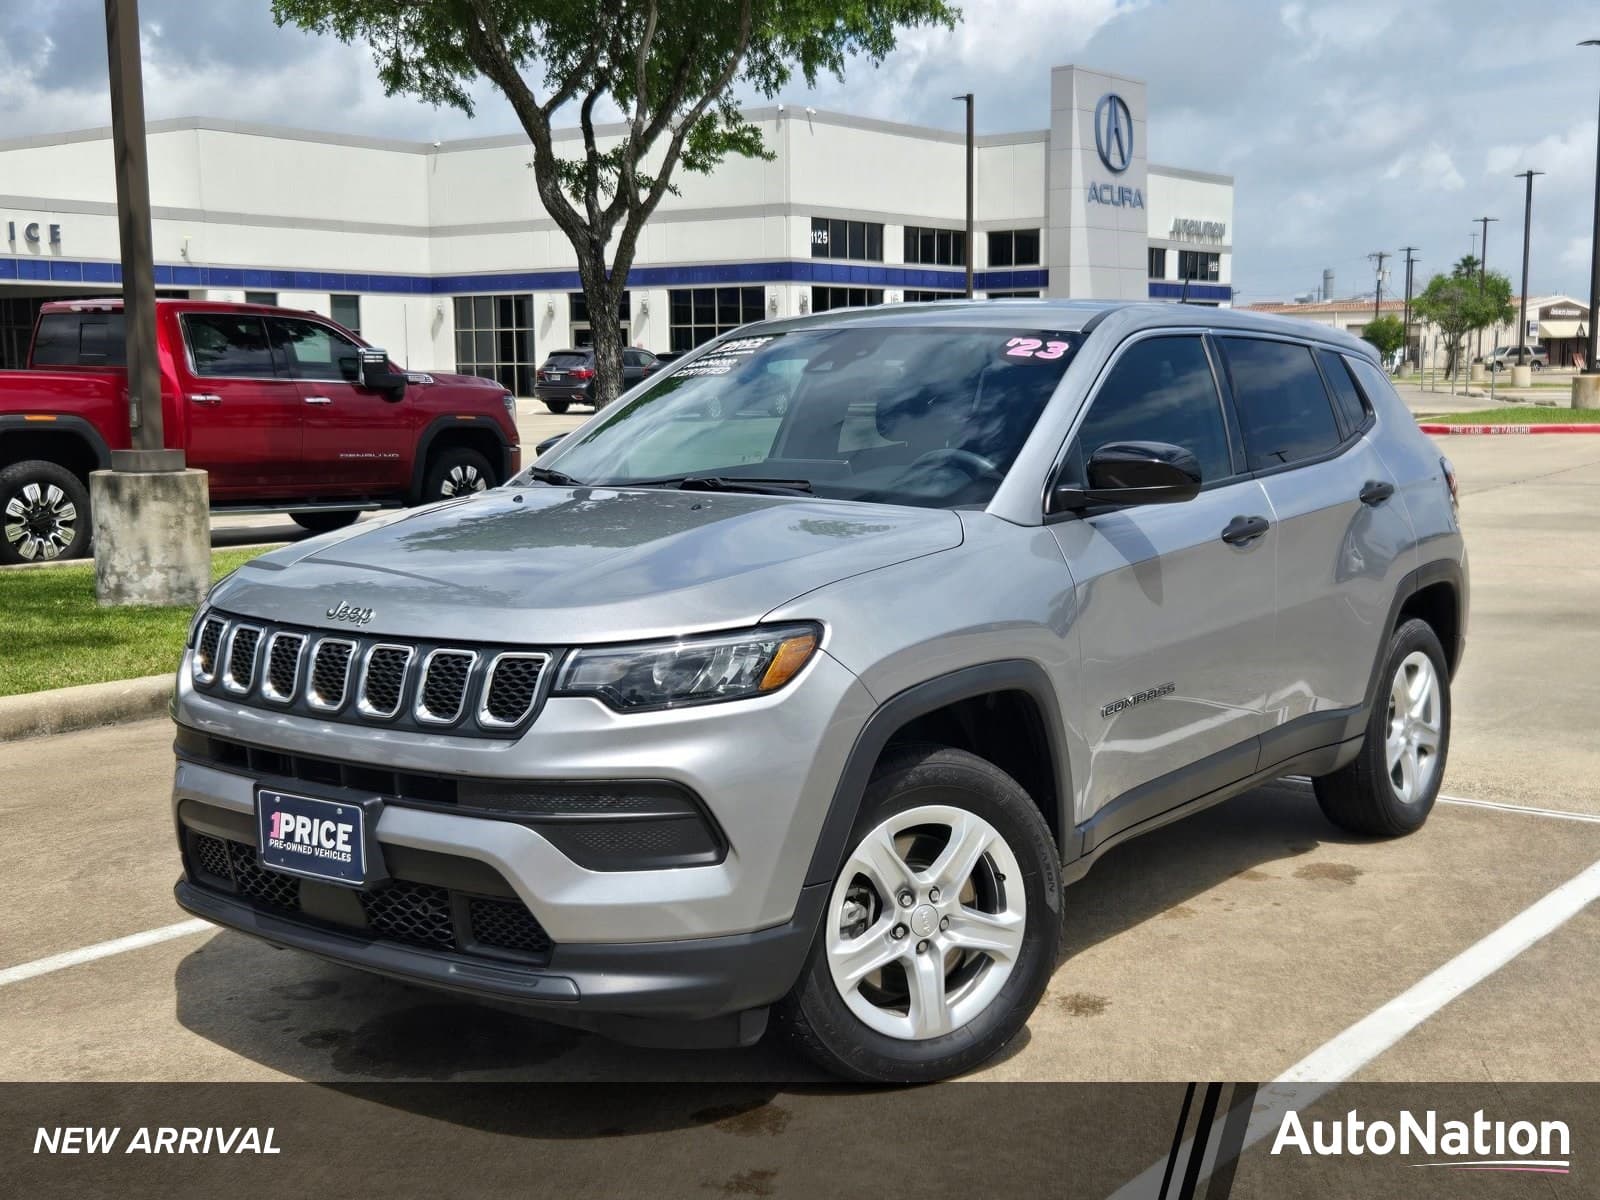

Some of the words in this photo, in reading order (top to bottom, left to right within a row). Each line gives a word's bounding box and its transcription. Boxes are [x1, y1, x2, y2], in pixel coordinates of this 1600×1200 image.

[1088, 181, 1144, 209] ACURA
[811, 229, 828, 244] 1125
[1501, 425, 1530, 434] PARKING
[327, 601, 376, 627] Jeep
[1101, 682, 1176, 717] COMPASS
[270, 811, 353, 852] 1PRICE
[269, 838, 313, 854] PRE-OWNED
[314, 847, 352, 862] VEHICLES
